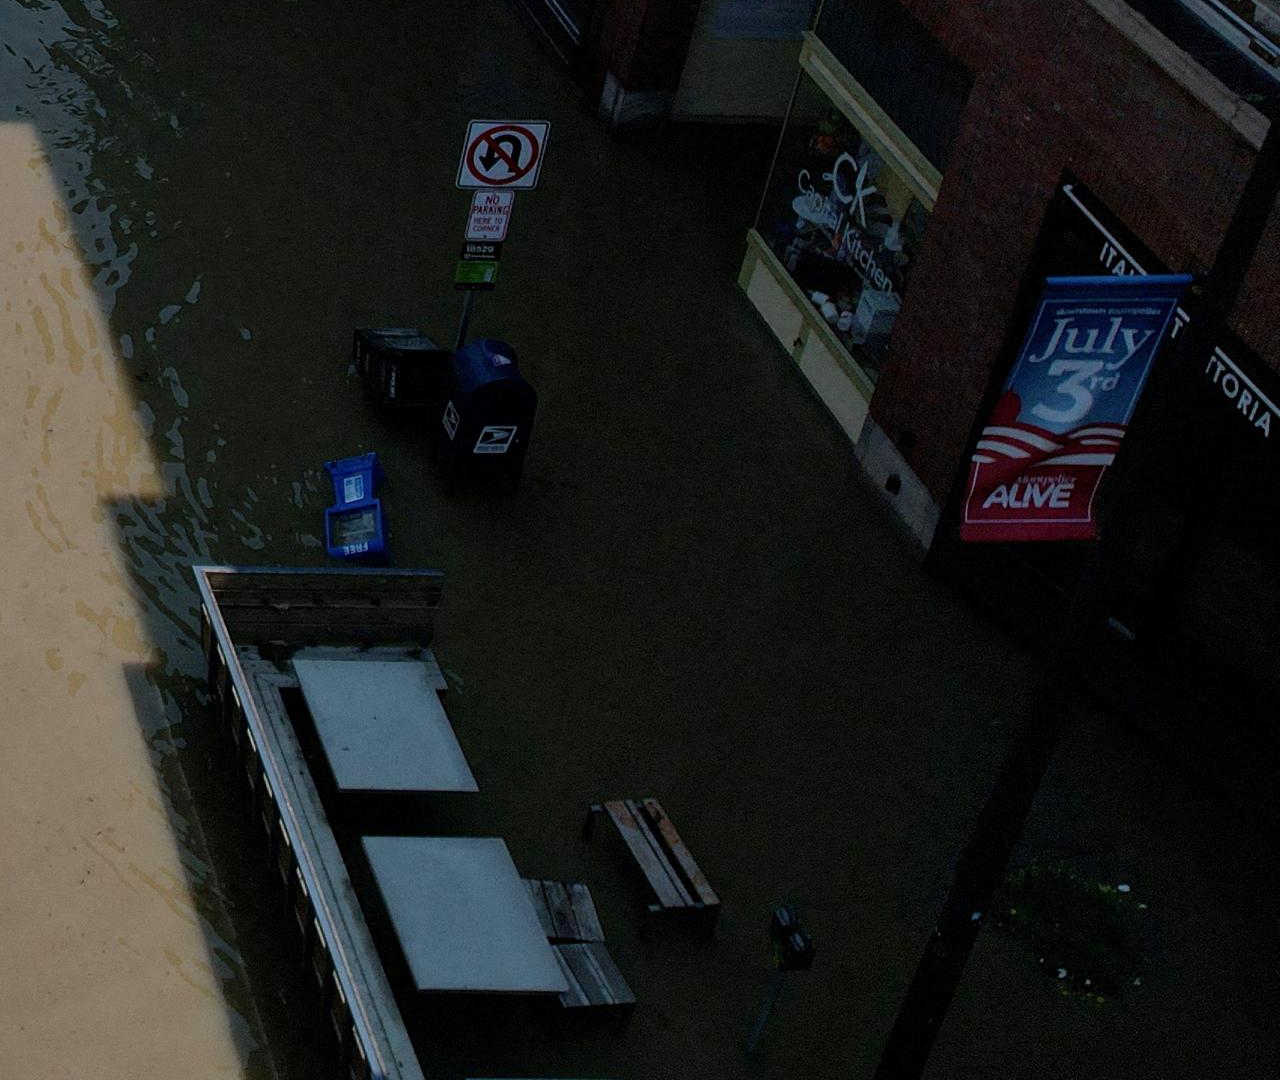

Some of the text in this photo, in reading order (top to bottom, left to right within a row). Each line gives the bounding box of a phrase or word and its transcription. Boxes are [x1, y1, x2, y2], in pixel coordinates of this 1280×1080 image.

[472, 206, 510, 215] PARKING
[486, 194, 500, 205] NO
[842, 221, 893, 293] Kitchen
[1028, 316, 1156, 371] July
[1032, 359, 1121, 422] 3rd
[982, 482, 1076, 510] ALIVE
[342, 541, 369, 556] FREE
